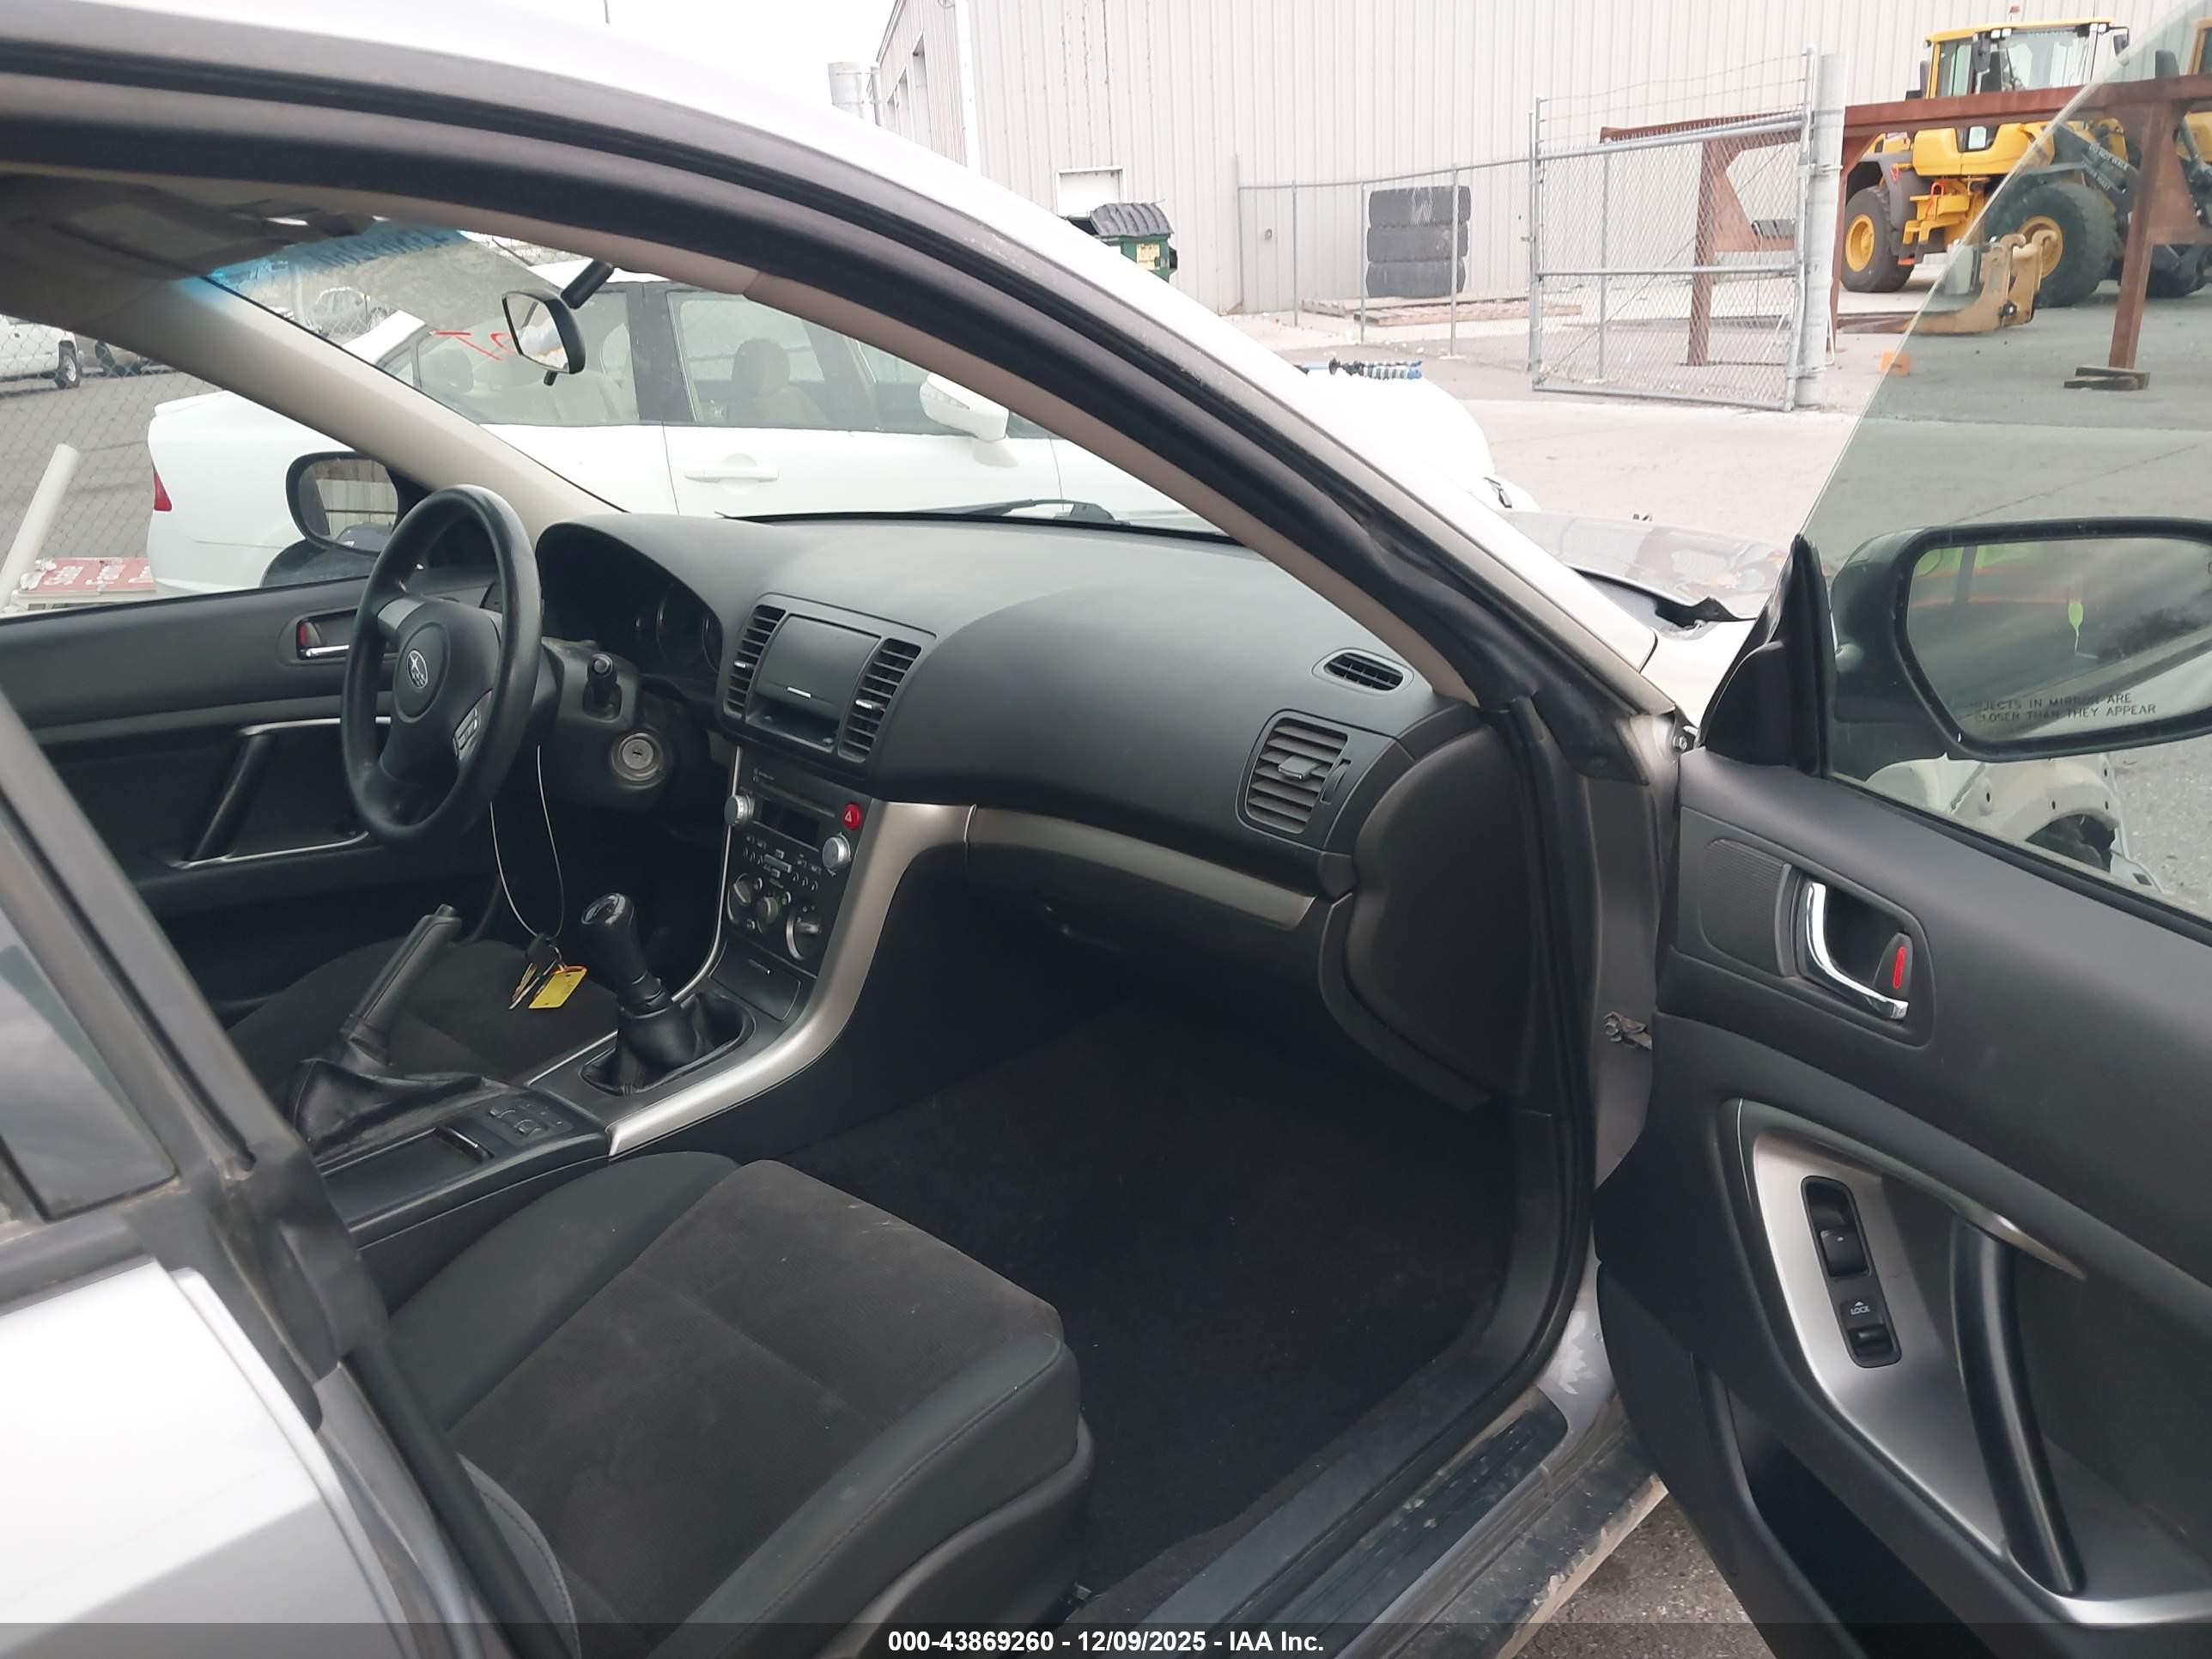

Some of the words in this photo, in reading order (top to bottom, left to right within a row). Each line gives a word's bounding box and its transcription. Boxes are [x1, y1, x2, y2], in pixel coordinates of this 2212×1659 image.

[2029, 698, 2043, 708] IN
[2106, 693, 2131, 704] ARE
[1975, 710, 2020, 722] CLOSER
[2068, 707, 2100, 719] THEY
[2106, 703, 2156, 716] APPEAR
[1850, 1305, 1870, 1315] LOCK
